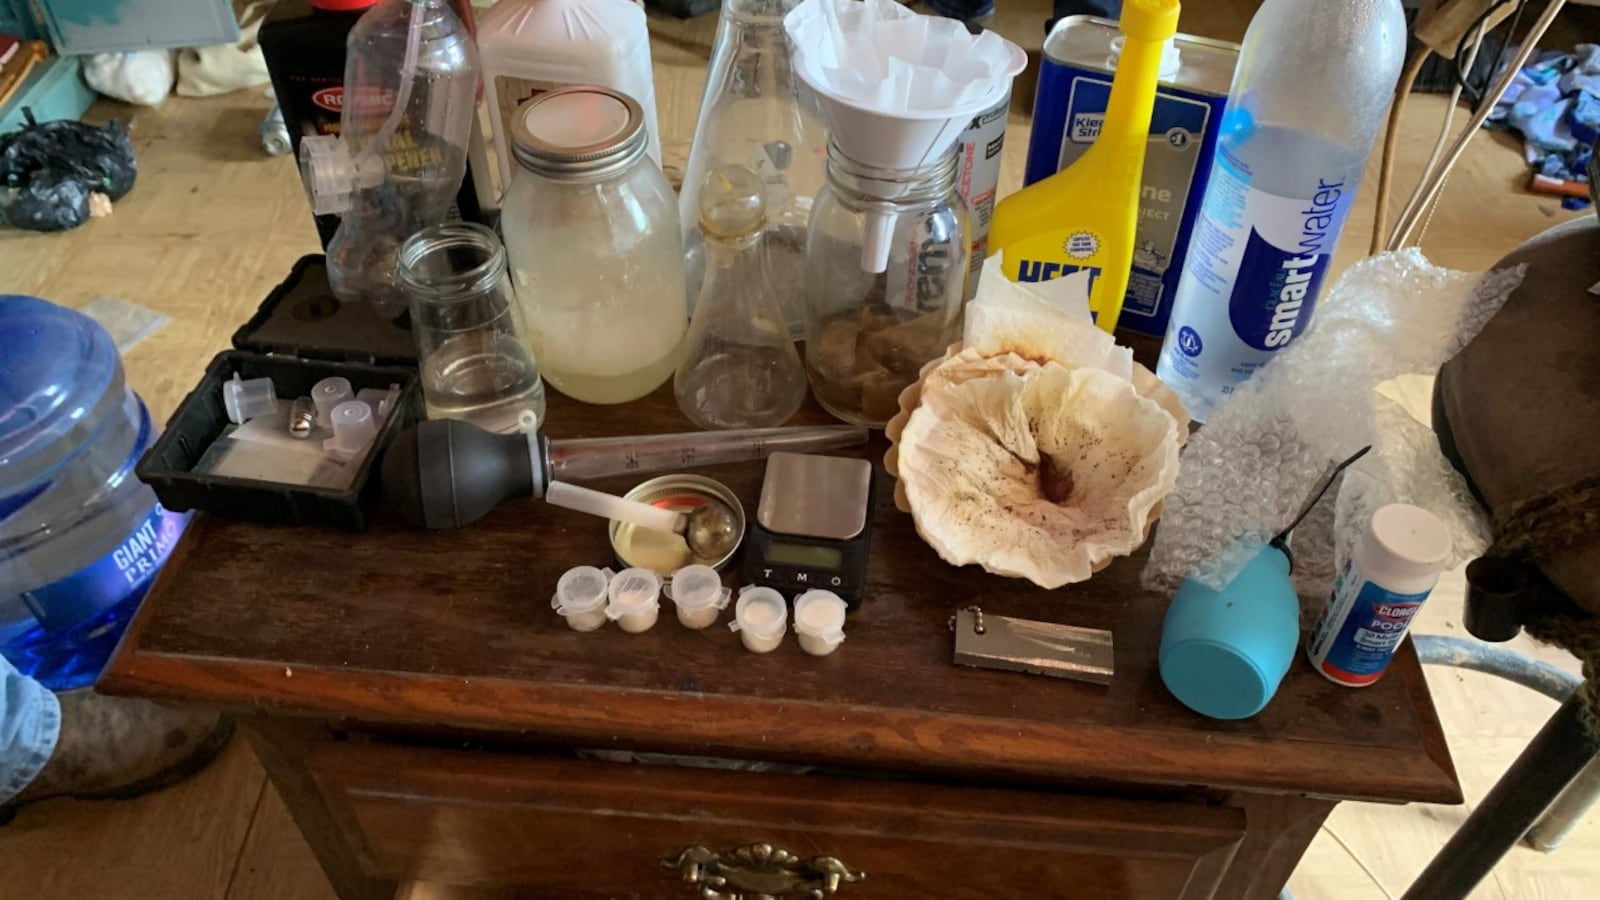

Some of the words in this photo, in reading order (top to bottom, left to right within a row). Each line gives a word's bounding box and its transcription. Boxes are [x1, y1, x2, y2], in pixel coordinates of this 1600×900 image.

[112, 518, 157, 570] GIANT
[124, 520, 177, 583] PRIMO
[764, 569, 773, 578] T
[796, 573, 808, 582] M
